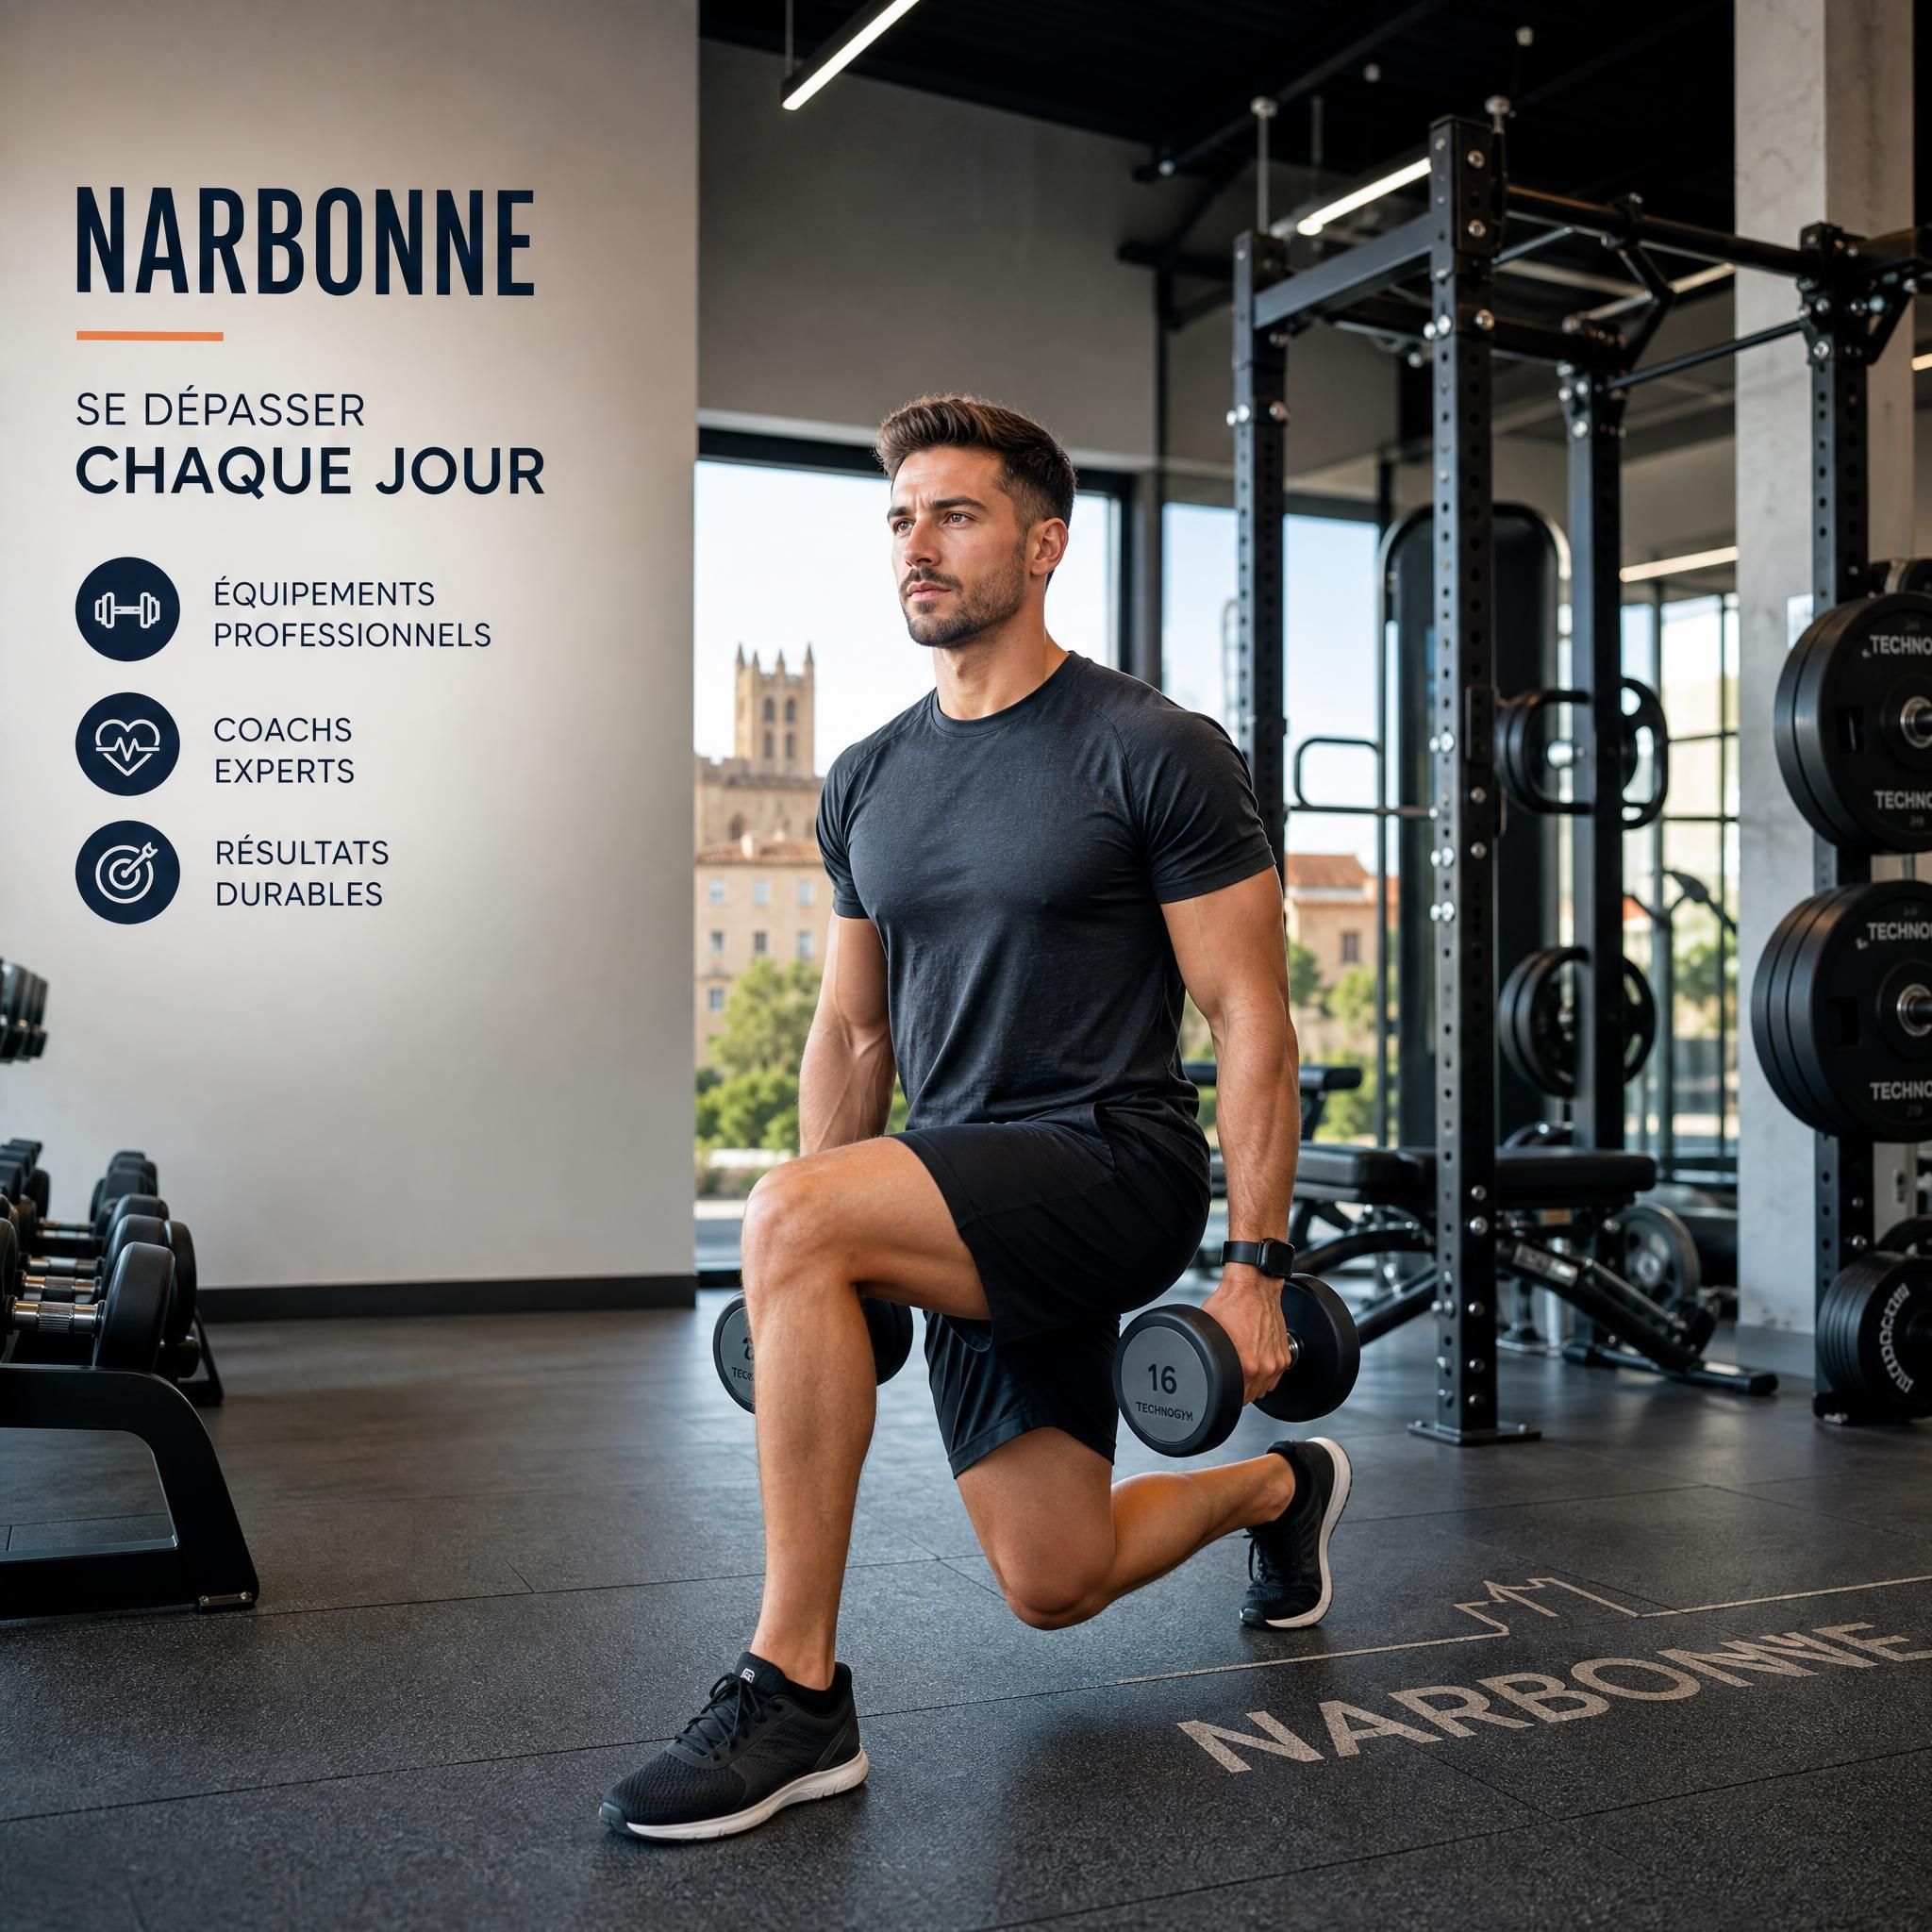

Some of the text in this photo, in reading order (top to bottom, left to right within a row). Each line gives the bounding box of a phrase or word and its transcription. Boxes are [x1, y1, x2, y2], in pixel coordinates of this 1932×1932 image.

[76, 186, 535, 297] NARBONNE
[76, 385, 364, 426] SE DÉPASSER
[75, 445, 545, 500] CHAQUE JOUR
[214, 575, 435, 609] ÉQUIPEMENTS
[214, 622, 491, 648] PROFESSIONNELS
[214, 717, 352, 742] COACHS
[215, 758, 355, 784] EXPERTS
[216, 835, 390, 866] RÉSULTATS
[216, 881, 383, 907] DURABLES
[1867, 922, 1932, 941] TECHNO
[1147, 1363, 1177, 1394] 16
[1135, 1401, 1193, 1422] TECHNOGYM
